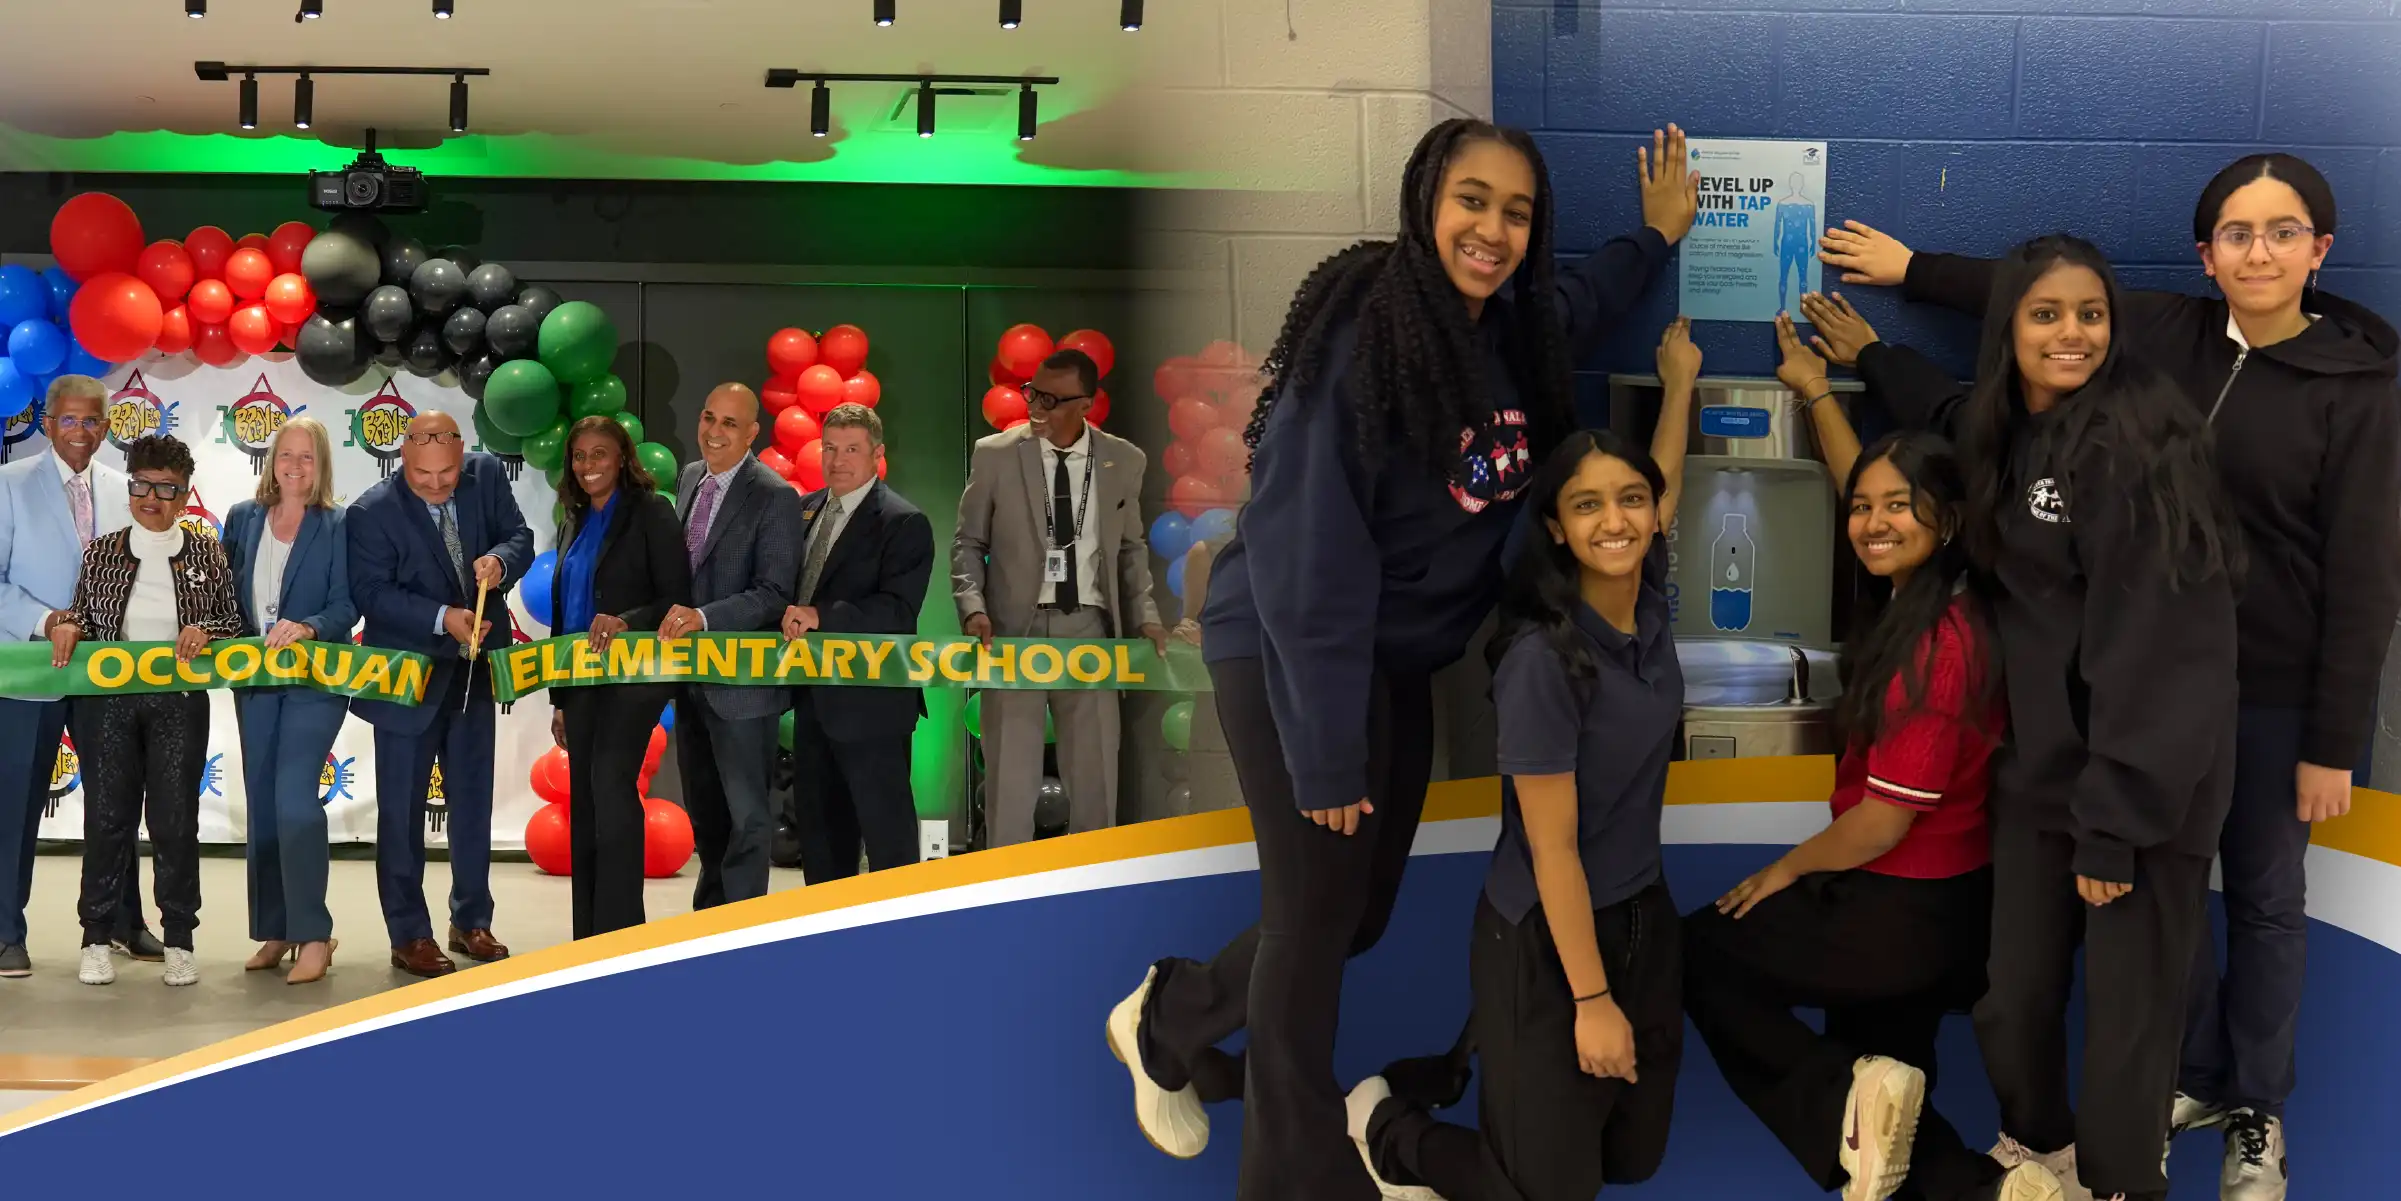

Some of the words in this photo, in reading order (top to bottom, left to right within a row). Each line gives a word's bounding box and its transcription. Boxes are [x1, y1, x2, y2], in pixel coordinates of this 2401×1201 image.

[1697, 176, 1744, 192] EVEL
[1749, 178, 1774, 193] UP
[1738, 195, 1772, 210] TAP
[108, 400, 161, 440] BRAVES
[362, 407, 412, 446] BRAVE
[87, 642, 433, 704] OCCOQUAN
[508, 637, 897, 692] ELEMENTARY
[908, 642, 1145, 683] SCHOOL
